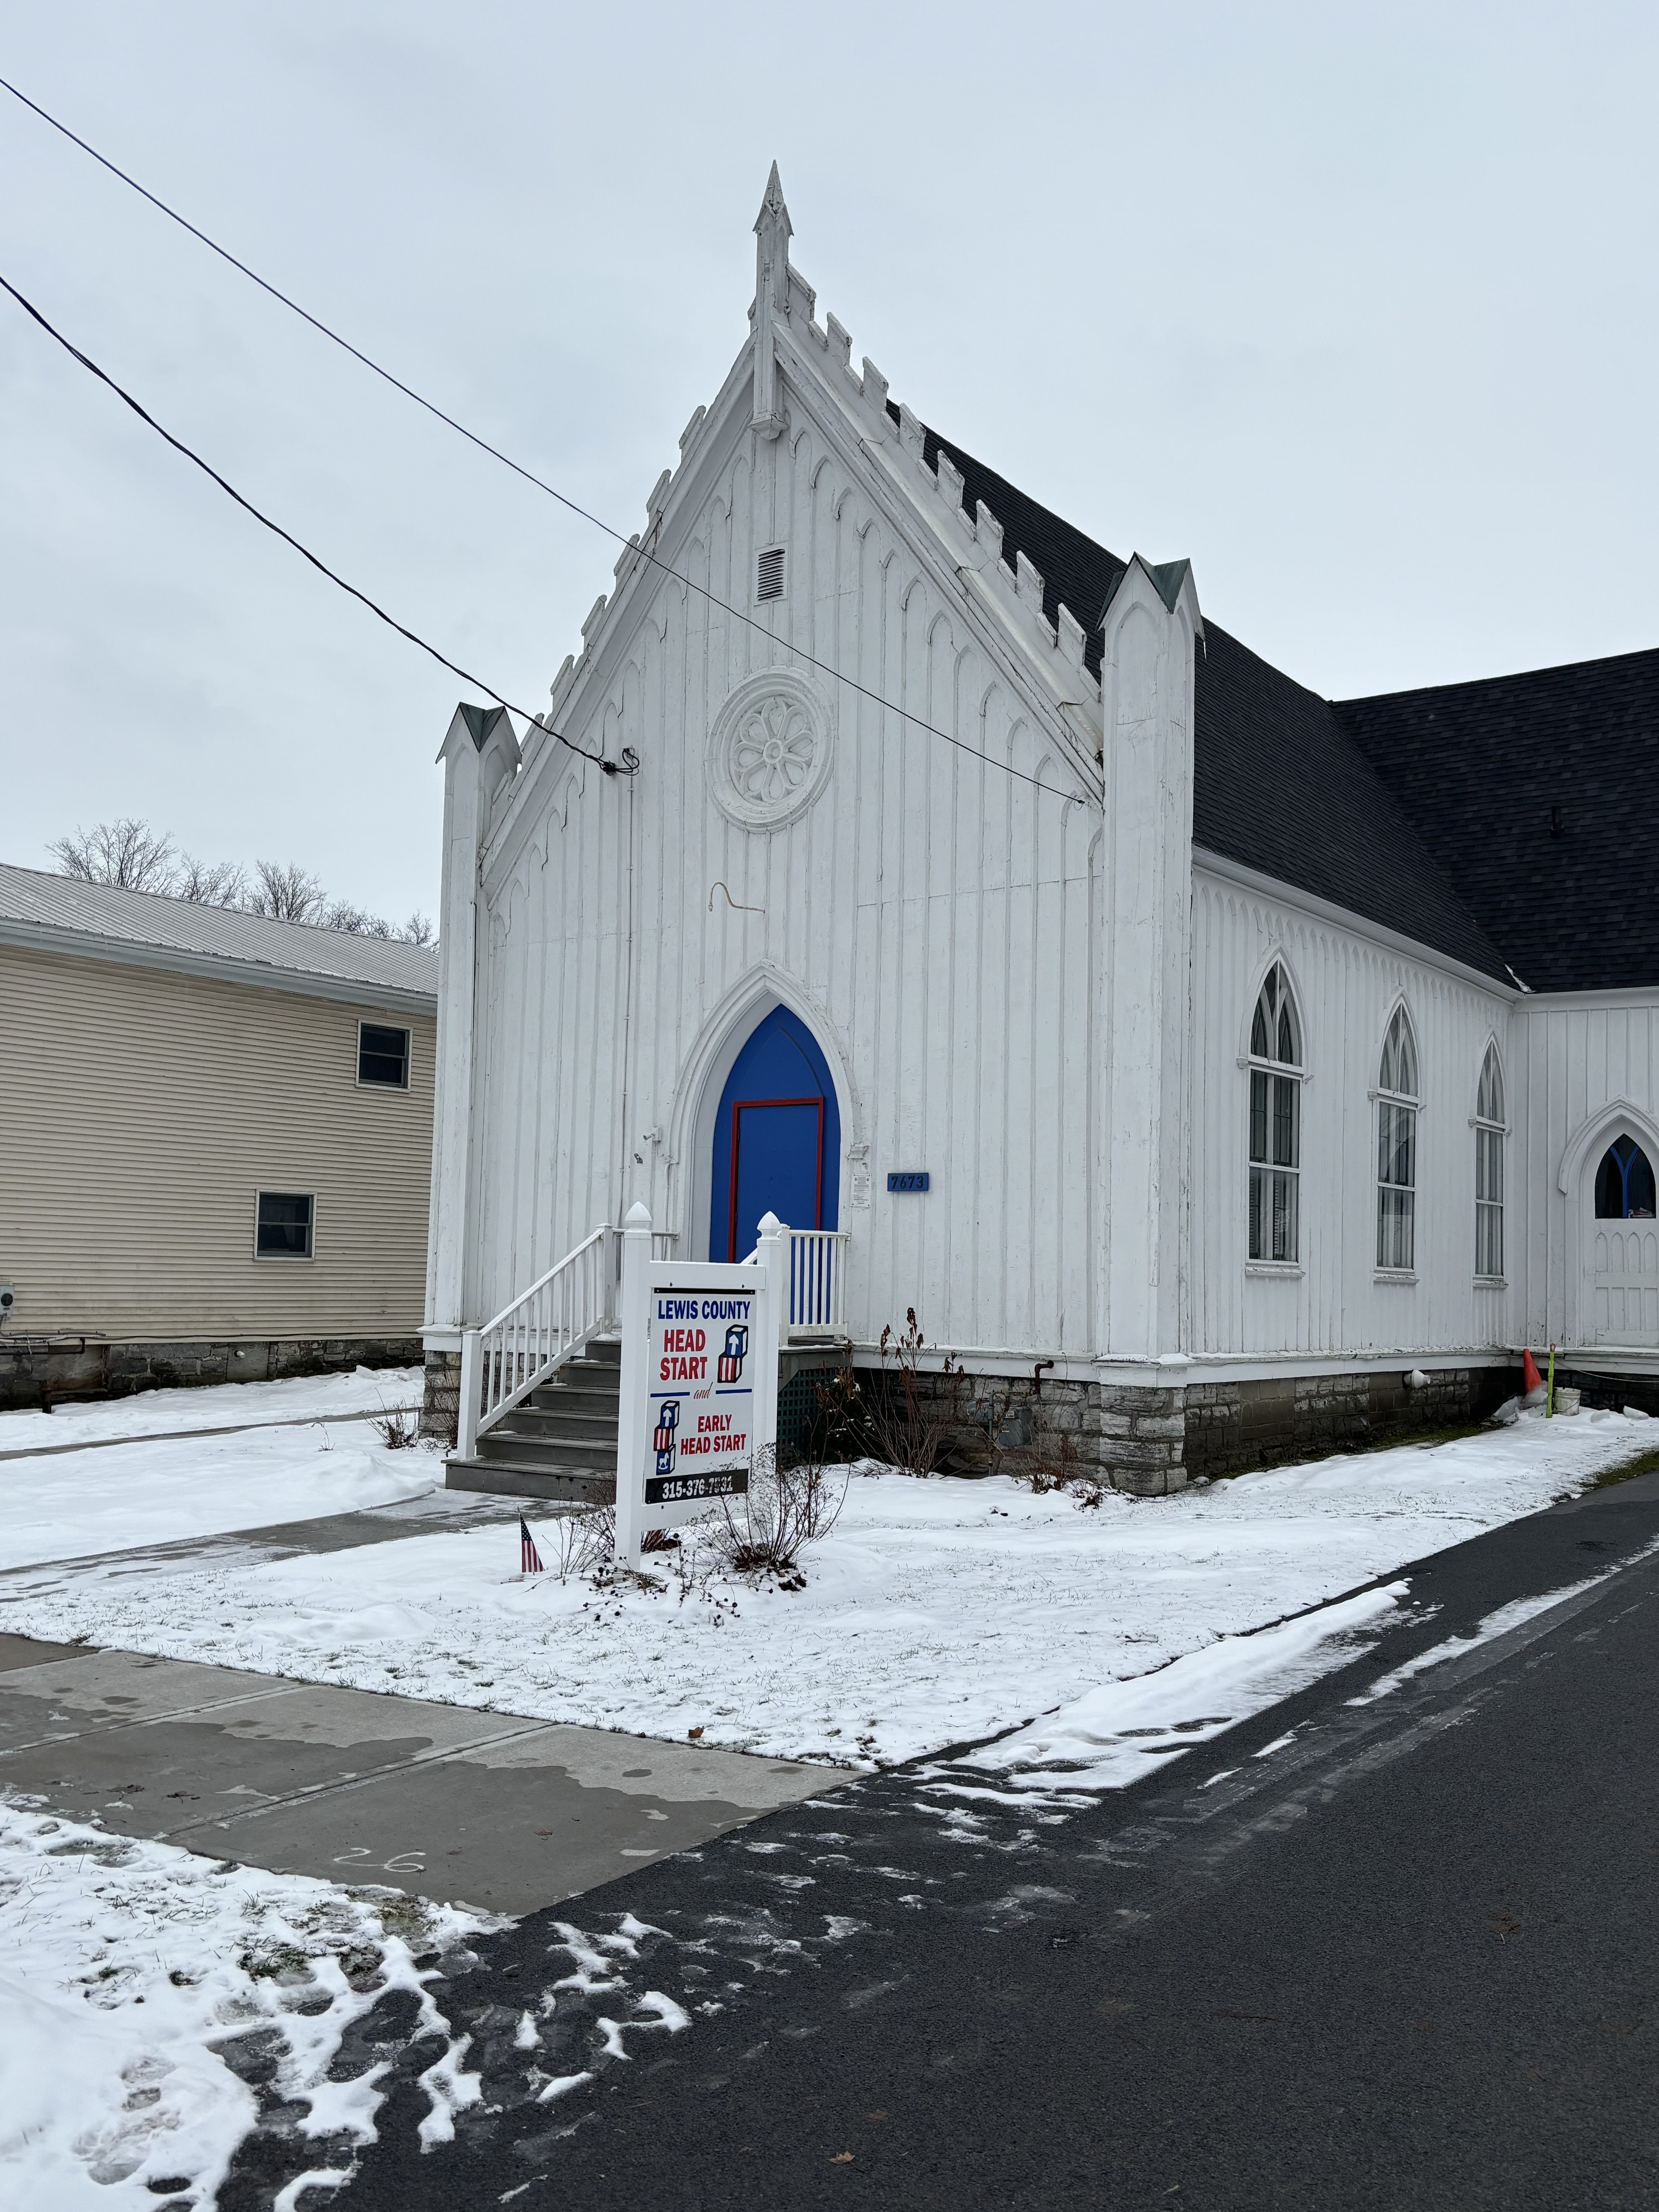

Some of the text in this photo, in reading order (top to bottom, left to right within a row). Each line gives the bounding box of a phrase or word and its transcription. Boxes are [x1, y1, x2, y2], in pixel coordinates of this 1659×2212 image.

[891, 1175, 923, 1189] 7673
[658, 1300, 750, 1319] LEWIS COUNTY
[664, 1329, 706, 1352] HEAD
[660, 1357, 708, 1381] START
[694, 1382, 713, 1400] and
[697, 1414, 732, 1432] EARLY
[680, 1434, 746, 1455] HEAD START
